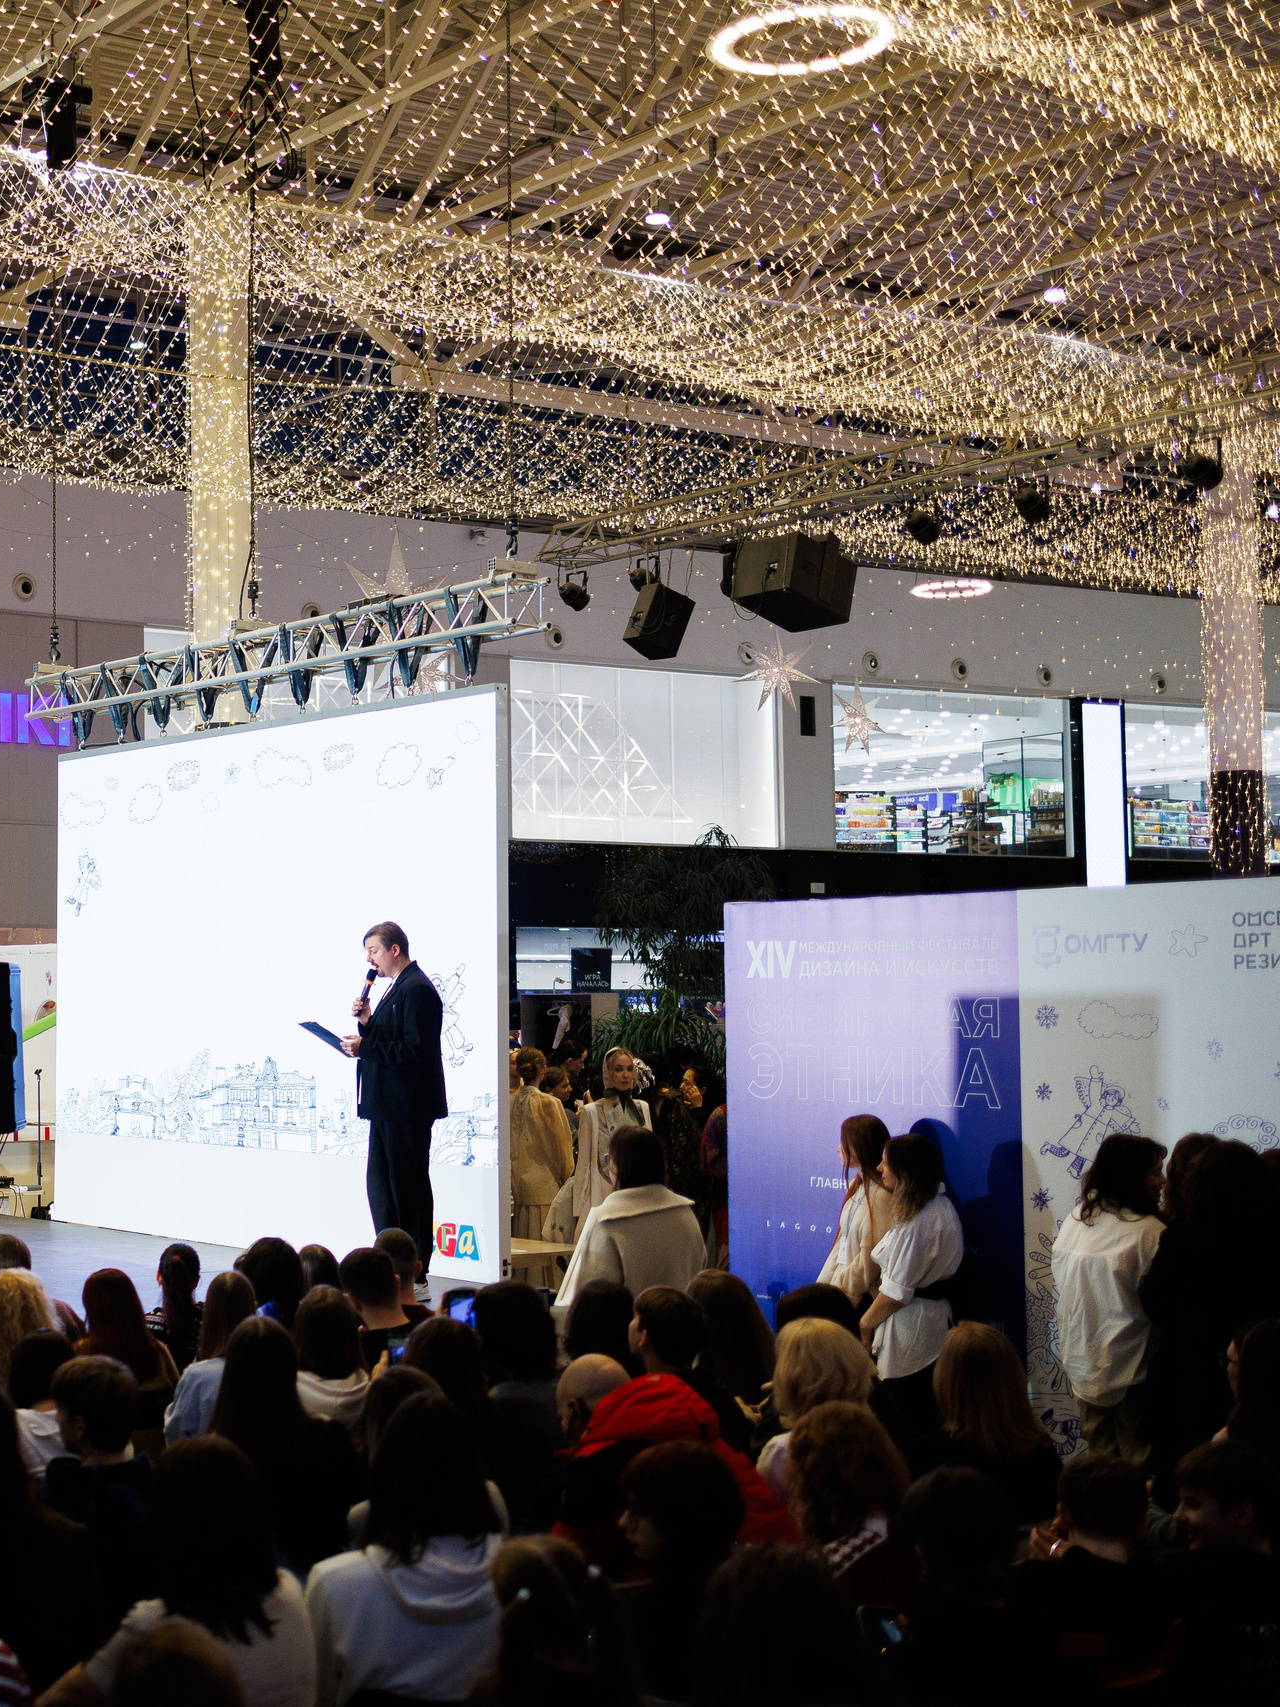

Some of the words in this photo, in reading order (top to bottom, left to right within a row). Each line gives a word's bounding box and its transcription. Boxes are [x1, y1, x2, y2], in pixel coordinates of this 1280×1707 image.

[1232, 910, 1280, 927] ОМС
[799, 937, 915, 955] МЕЖДУНАРОДНЫЙ
[918, 937, 999, 952] ФЕСТИВАЛЬ
[1064, 933, 1149, 954] ОМГТУ
[746, 940, 797, 979] XIV
[799, 956, 880, 980] ДИЗАЙНА
[884, 959, 898, 976] И
[902, 957, 1000, 976] ИСКУССТВ
[576, 980, 609, 988] НАЧАЛАСЬ
[746, 995, 1000, 1039] СИБИРСКАЯ
[747, 1042, 1001, 1110] ЭТНИКА
[810, 1176, 847, 1190] ГЛАВН
[766, 1220, 832, 1234] LAGOO
